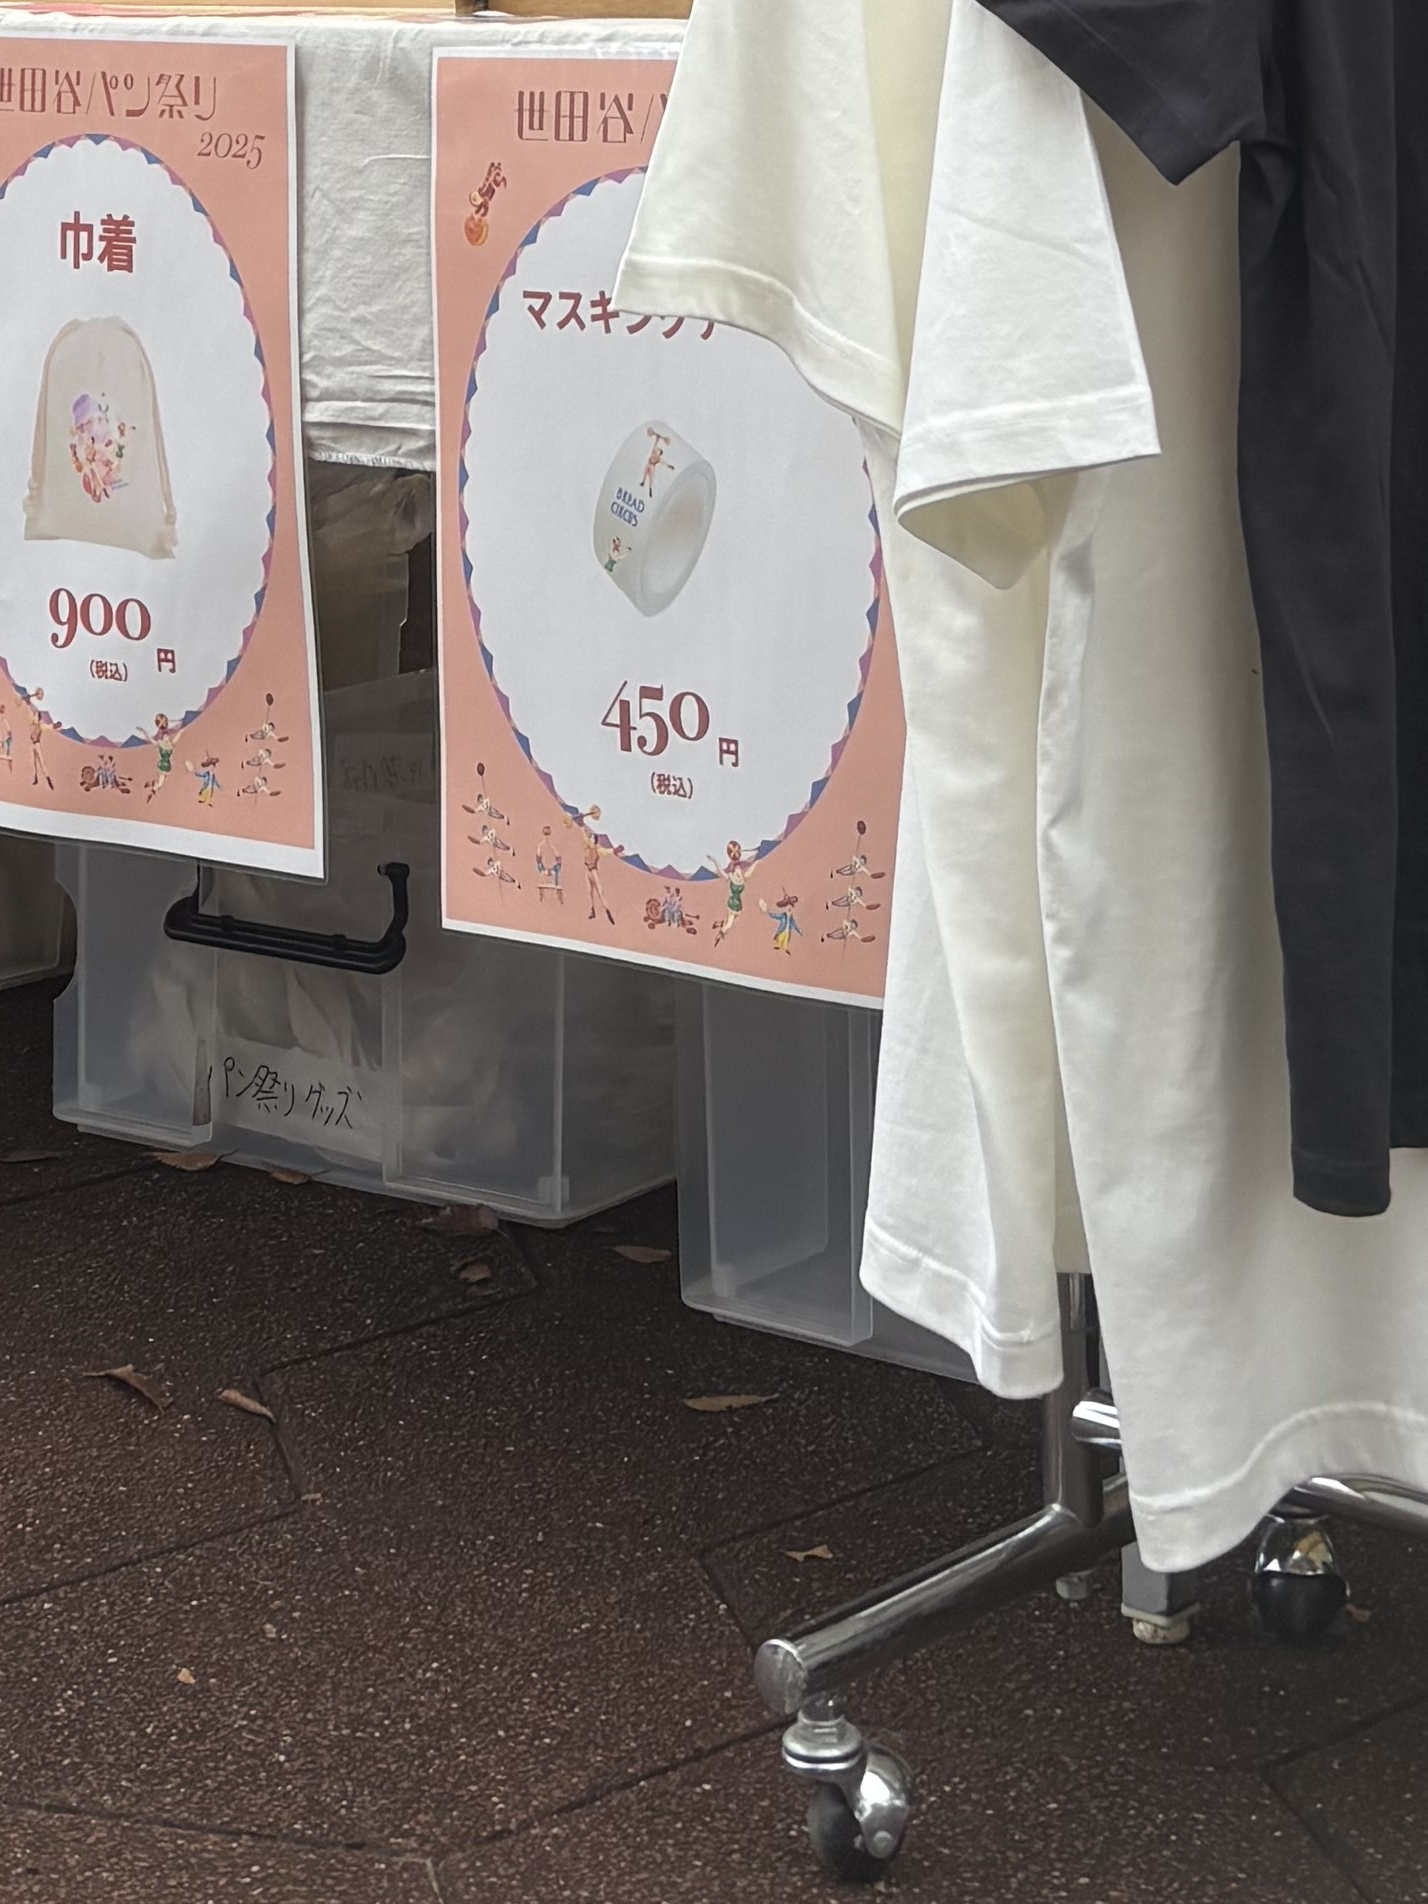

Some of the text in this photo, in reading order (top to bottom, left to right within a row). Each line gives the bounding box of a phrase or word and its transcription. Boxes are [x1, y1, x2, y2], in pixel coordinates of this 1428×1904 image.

[197, 129, 266, 170] 2025
[59, 211, 138, 275] 巾着
[88, 659, 129, 683] (税込)
[649, 770, 694, 799] (税込)
[305, 1081, 363, 1129] グッズ
